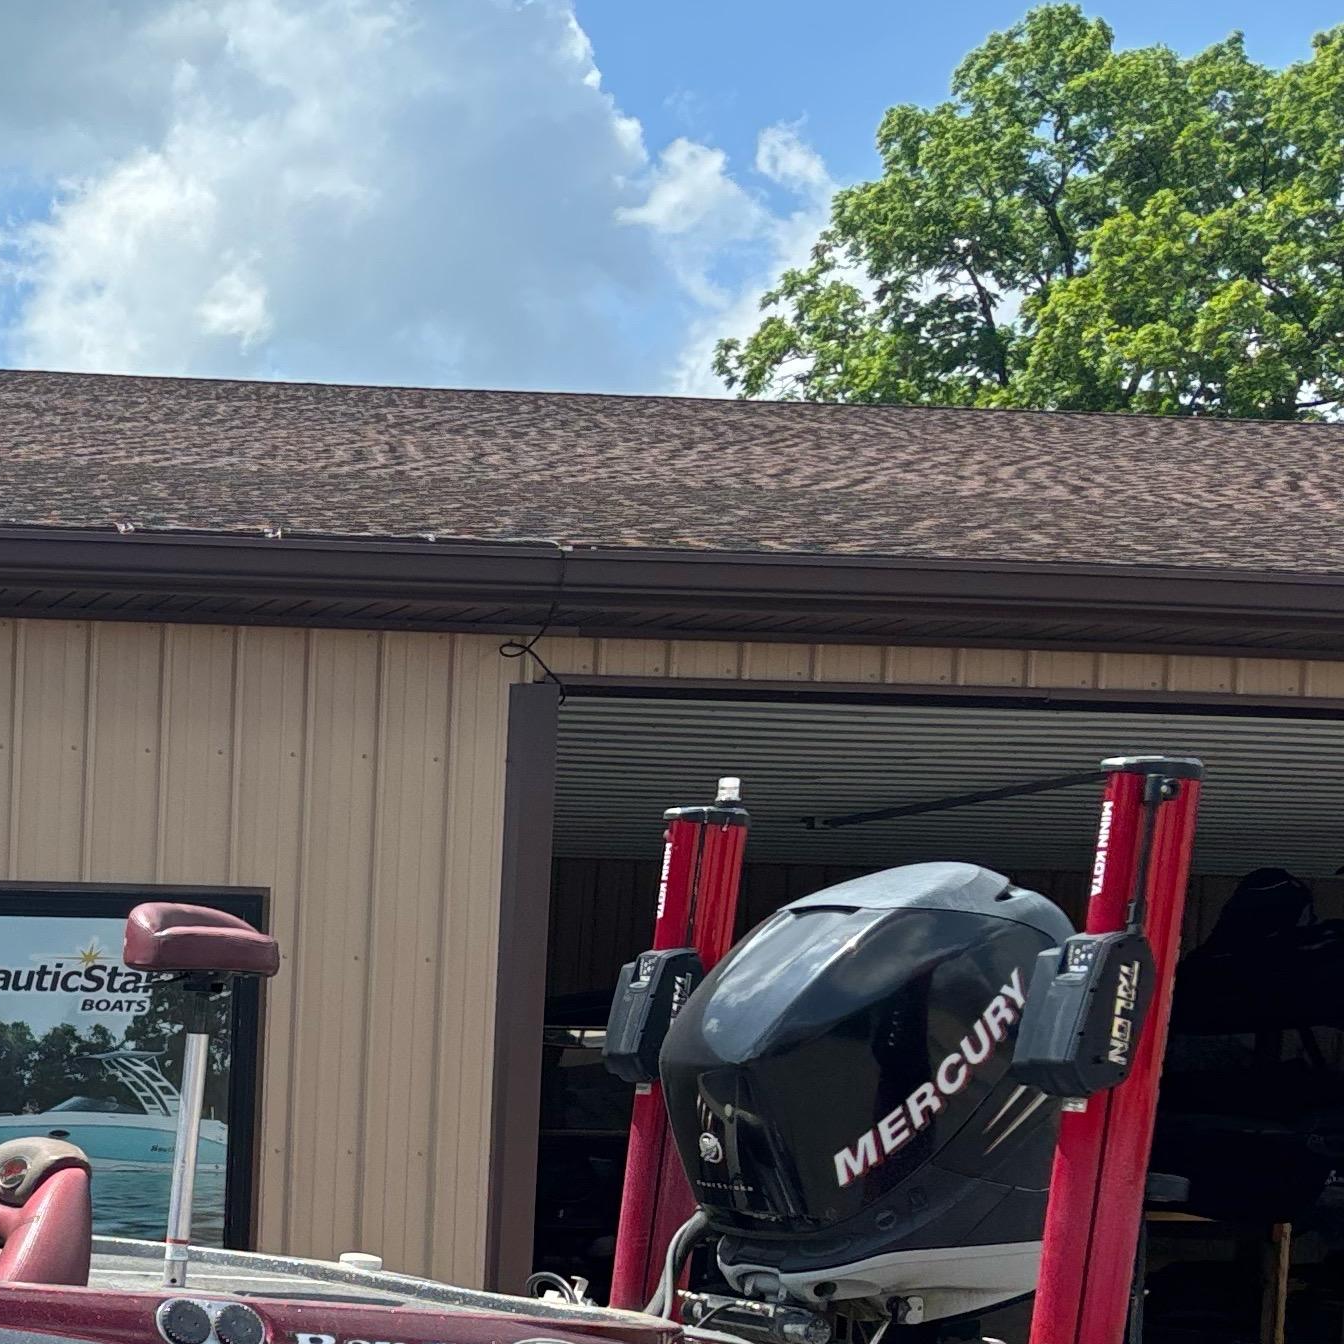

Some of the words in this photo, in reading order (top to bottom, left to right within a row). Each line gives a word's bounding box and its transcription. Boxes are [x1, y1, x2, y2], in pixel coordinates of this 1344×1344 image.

[1097, 800, 1113, 848] MINN
[1090, 850, 1108, 897] KOTA
[81, 998, 147, 1013] BOATS
[1108, 960, 1141, 1066] TALON
[834, 967, 1026, 1187] MERCURY
